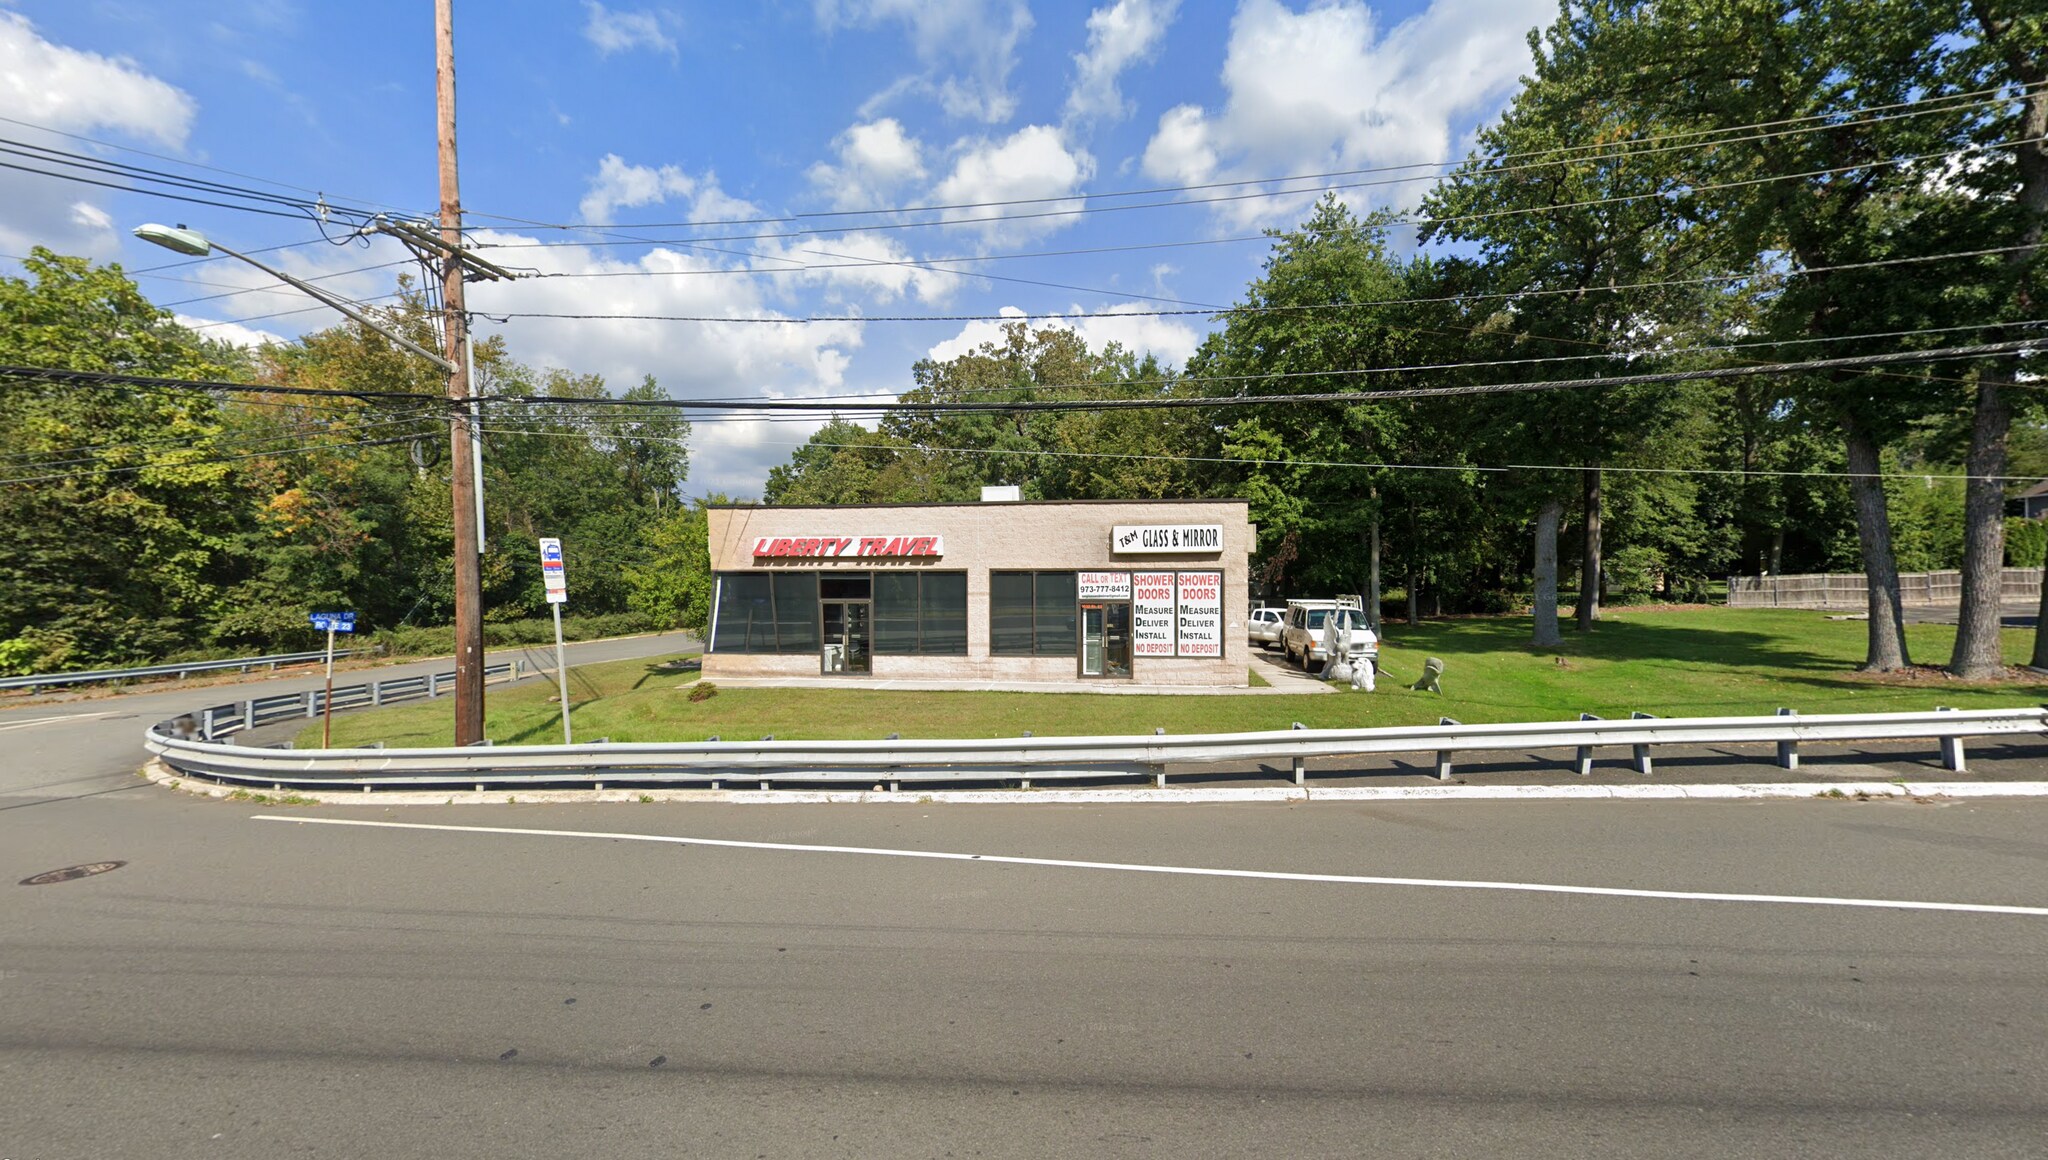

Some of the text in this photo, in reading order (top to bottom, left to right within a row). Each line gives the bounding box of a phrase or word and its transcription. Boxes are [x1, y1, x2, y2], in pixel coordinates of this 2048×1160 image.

[1119, 529, 1219, 548] T&M GLASS & MIRROR
[752, 537, 938, 556] LIBERTY TRAVEL
[1081, 573, 1127, 584] CALL OR TEXT
[1133, 575, 1174, 586] SHOWER
[1178, 575, 1220, 586] SHOWER
[1080, 585, 1129, 593] 973-777-8412
[1137, 588, 1170, 600] DOORS
[1182, 588, 1216, 600] DOORS
[1135, 604, 1173, 615] MEASURE
[1180, 604, 1219, 615] MEASURE
[1135, 617, 1169, 627] DELIVER
[1180, 617, 1215, 627] DELIVER
[1135, 629, 1167, 639] INSTALL
[1180, 629, 1213, 639] INSTALL
[1135, 643, 1173, 653] NO DEPOSIT
[1180, 643, 1219, 653] NO DEPOSIT
